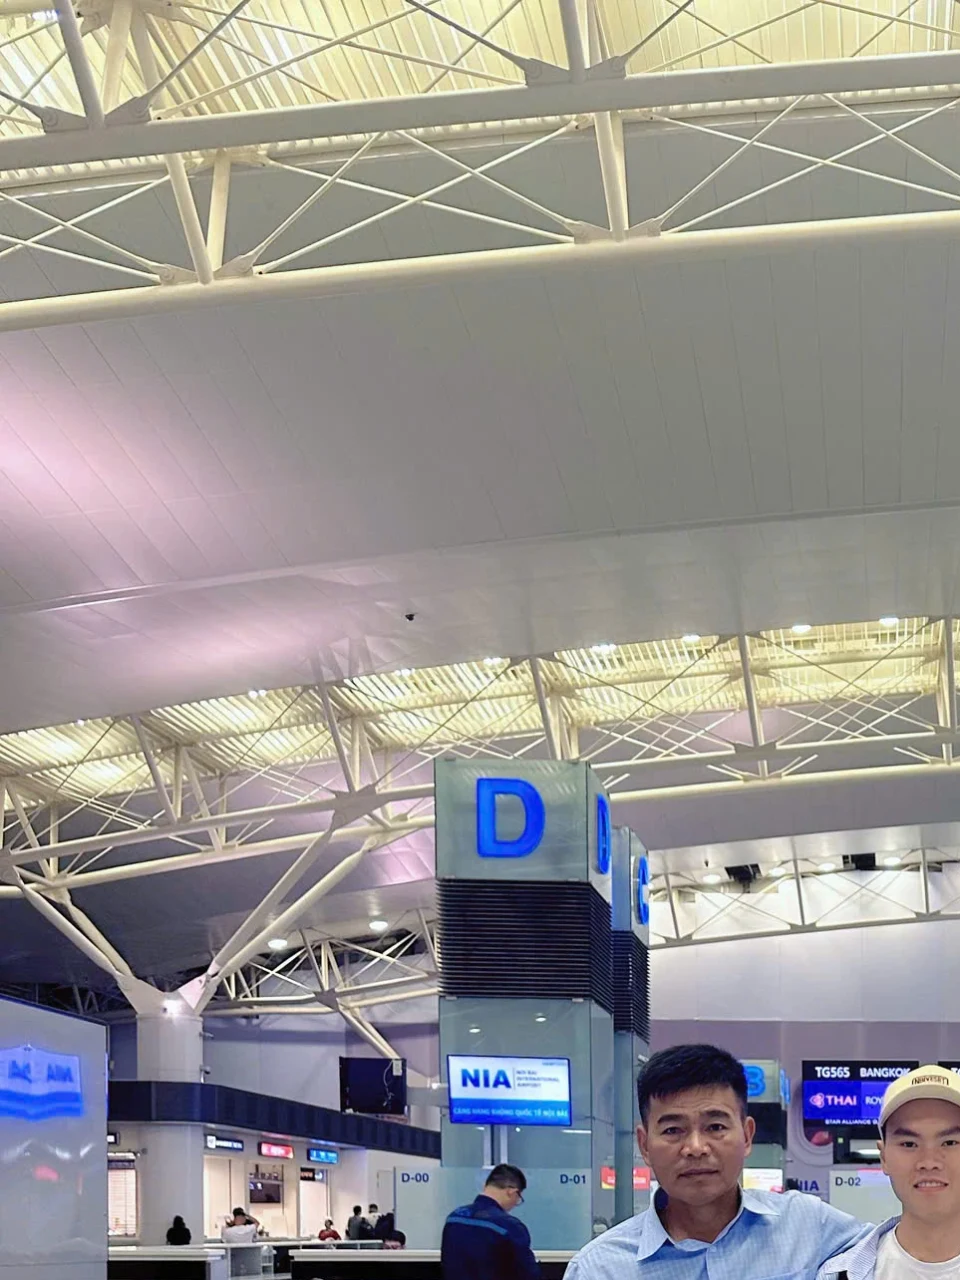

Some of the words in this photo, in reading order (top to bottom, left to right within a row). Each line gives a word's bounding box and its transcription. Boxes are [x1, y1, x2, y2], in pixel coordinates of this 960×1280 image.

[476, 777, 546, 858] D
[815, 1066, 850, 1078] TG565
[860, 1067, 910, 1078] BANGKOK
[461, 1069, 512, 1088] NIA
[825, 1095, 857, 1106] THAI
[865, 1096, 883, 1105] ROY
[401, 1172, 429, 1183] D-00
[560, 1174, 586, 1184] D-01
[835, 1177, 861, 1187] D-02
